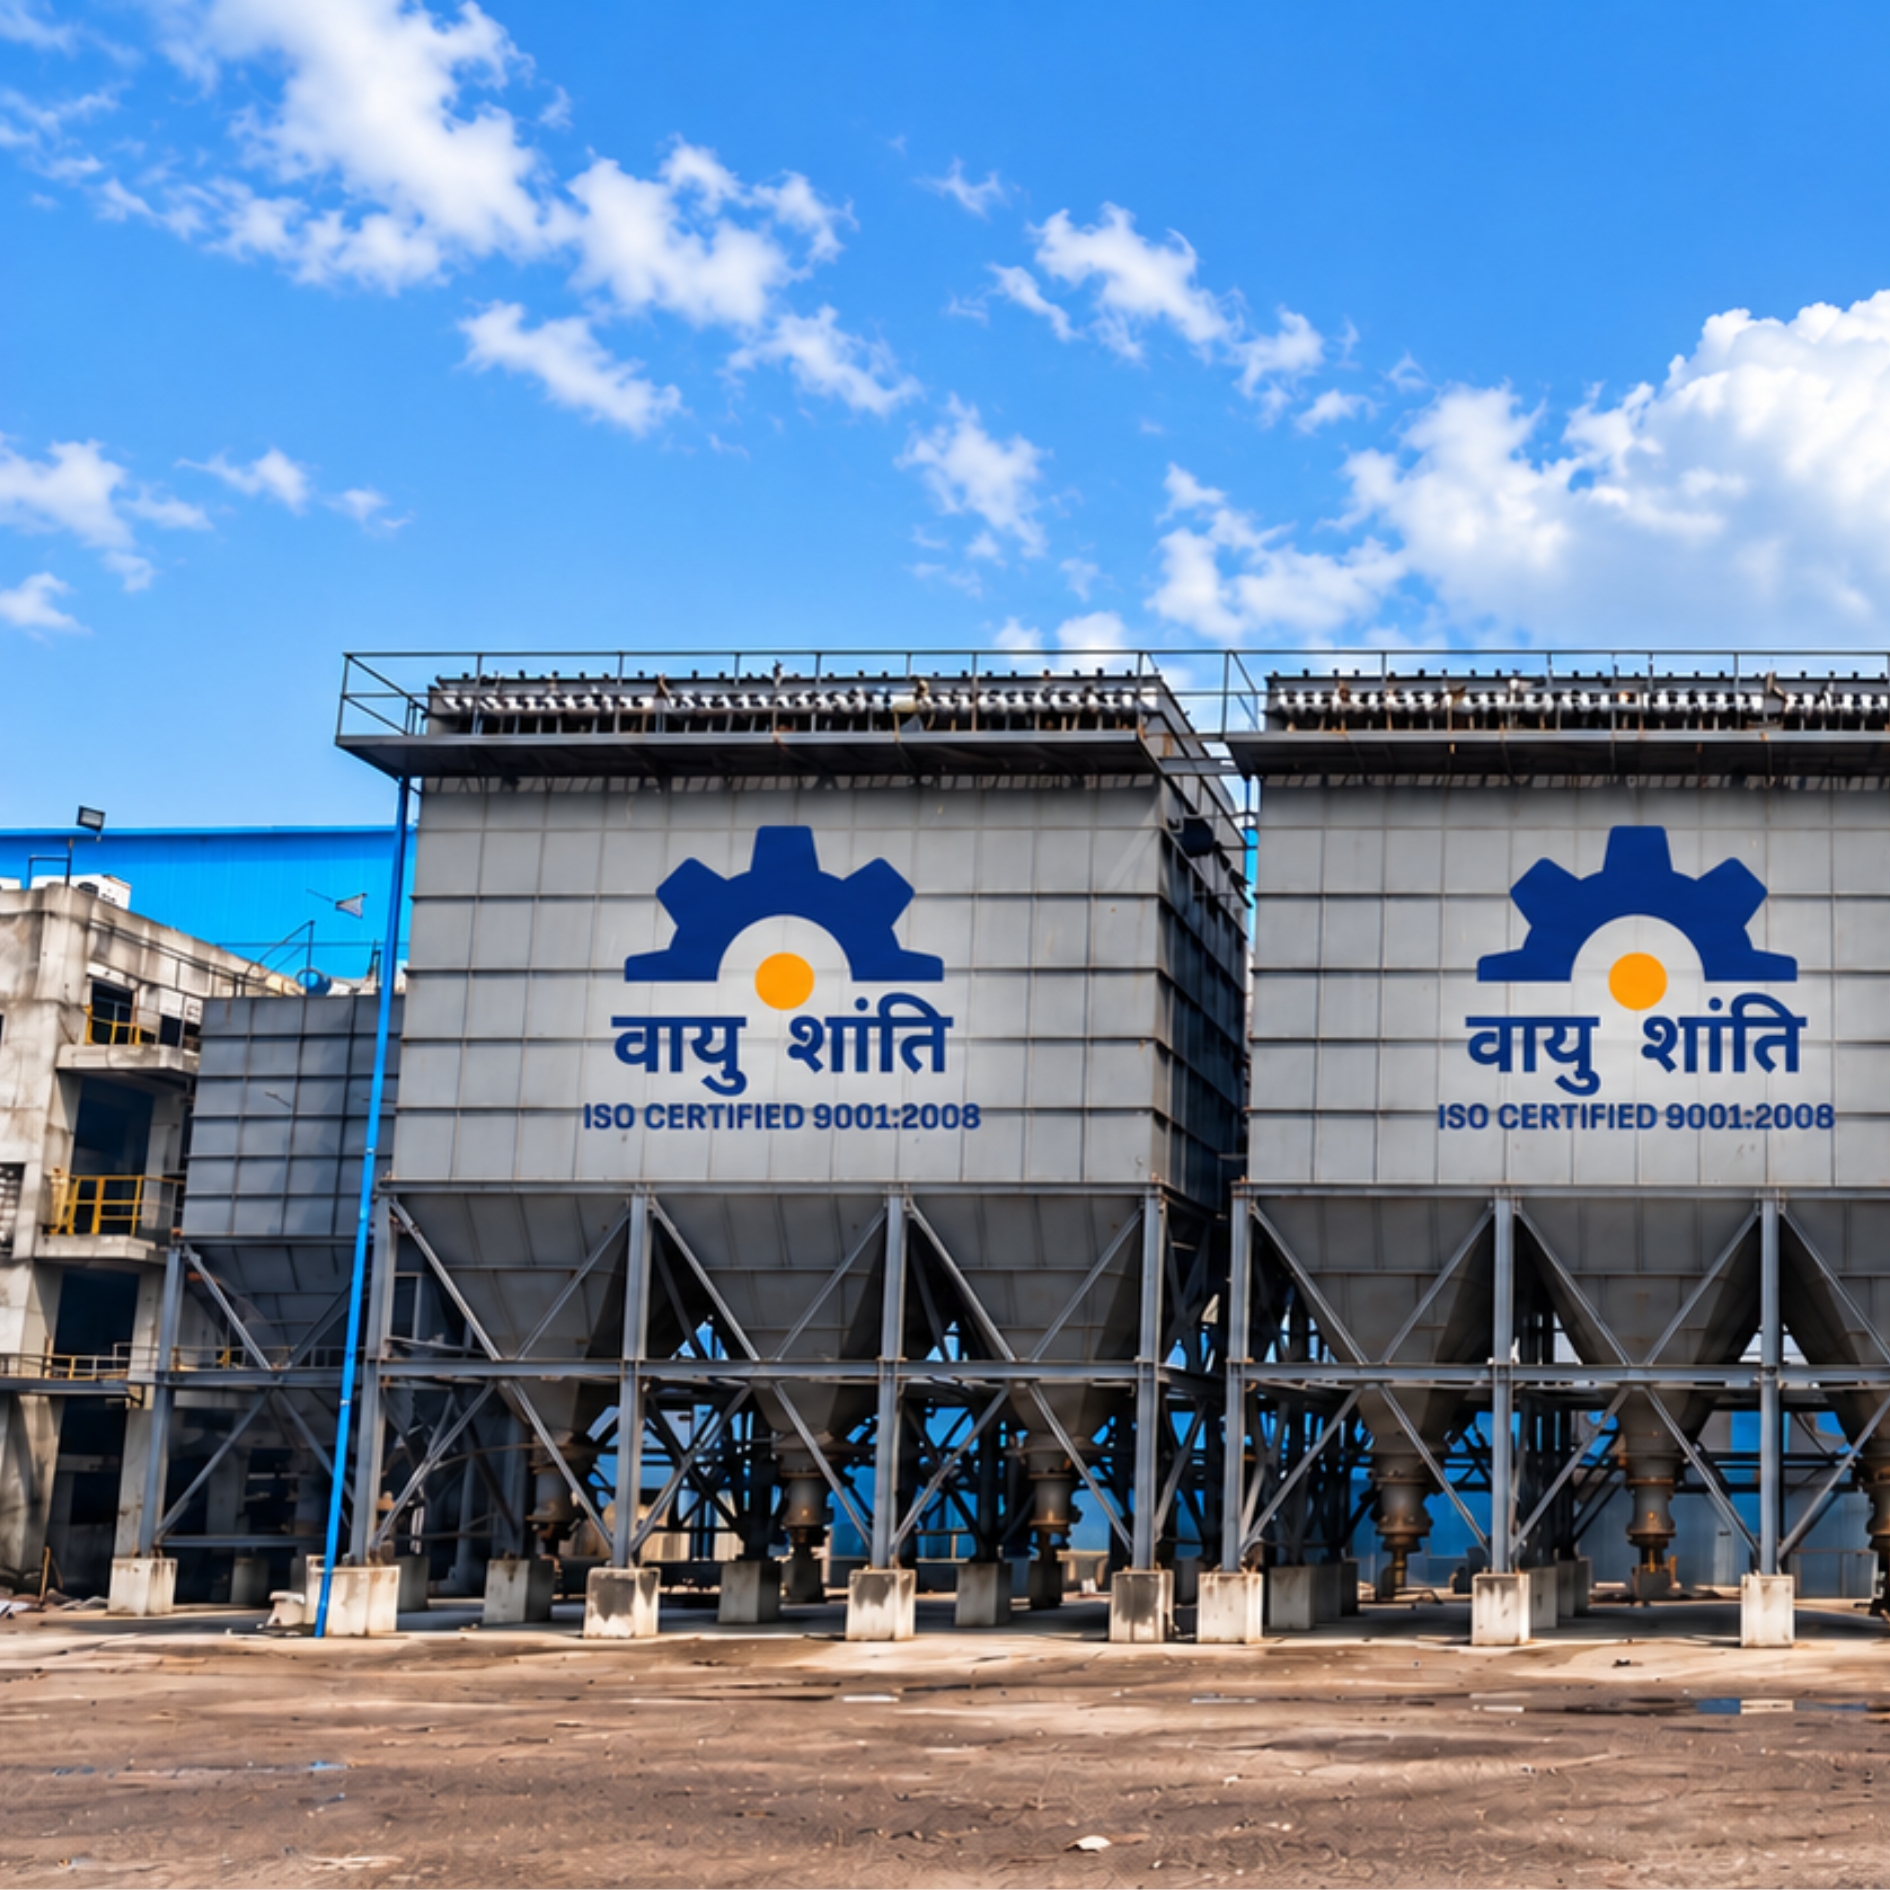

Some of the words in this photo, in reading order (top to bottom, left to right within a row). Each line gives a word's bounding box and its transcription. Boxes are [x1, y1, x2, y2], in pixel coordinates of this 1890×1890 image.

[611, 1016, 747, 1096] वायु
[787, 992, 954, 1073] शांति
[1465, 1016, 1601, 1097] वायु
[1641, 992, 1807, 1073] शांति
[583, 1103, 636, 1130] ISO
[643, 1103, 805, 1130] CERTIFIED
[812, 1103, 981, 1130] 9001:2008
[1437, 1103, 1490, 1130] ISO
[1497, 1103, 1658, 1130] CERTIFIED
[1665, 1103, 1835, 1130] 9001:2008
